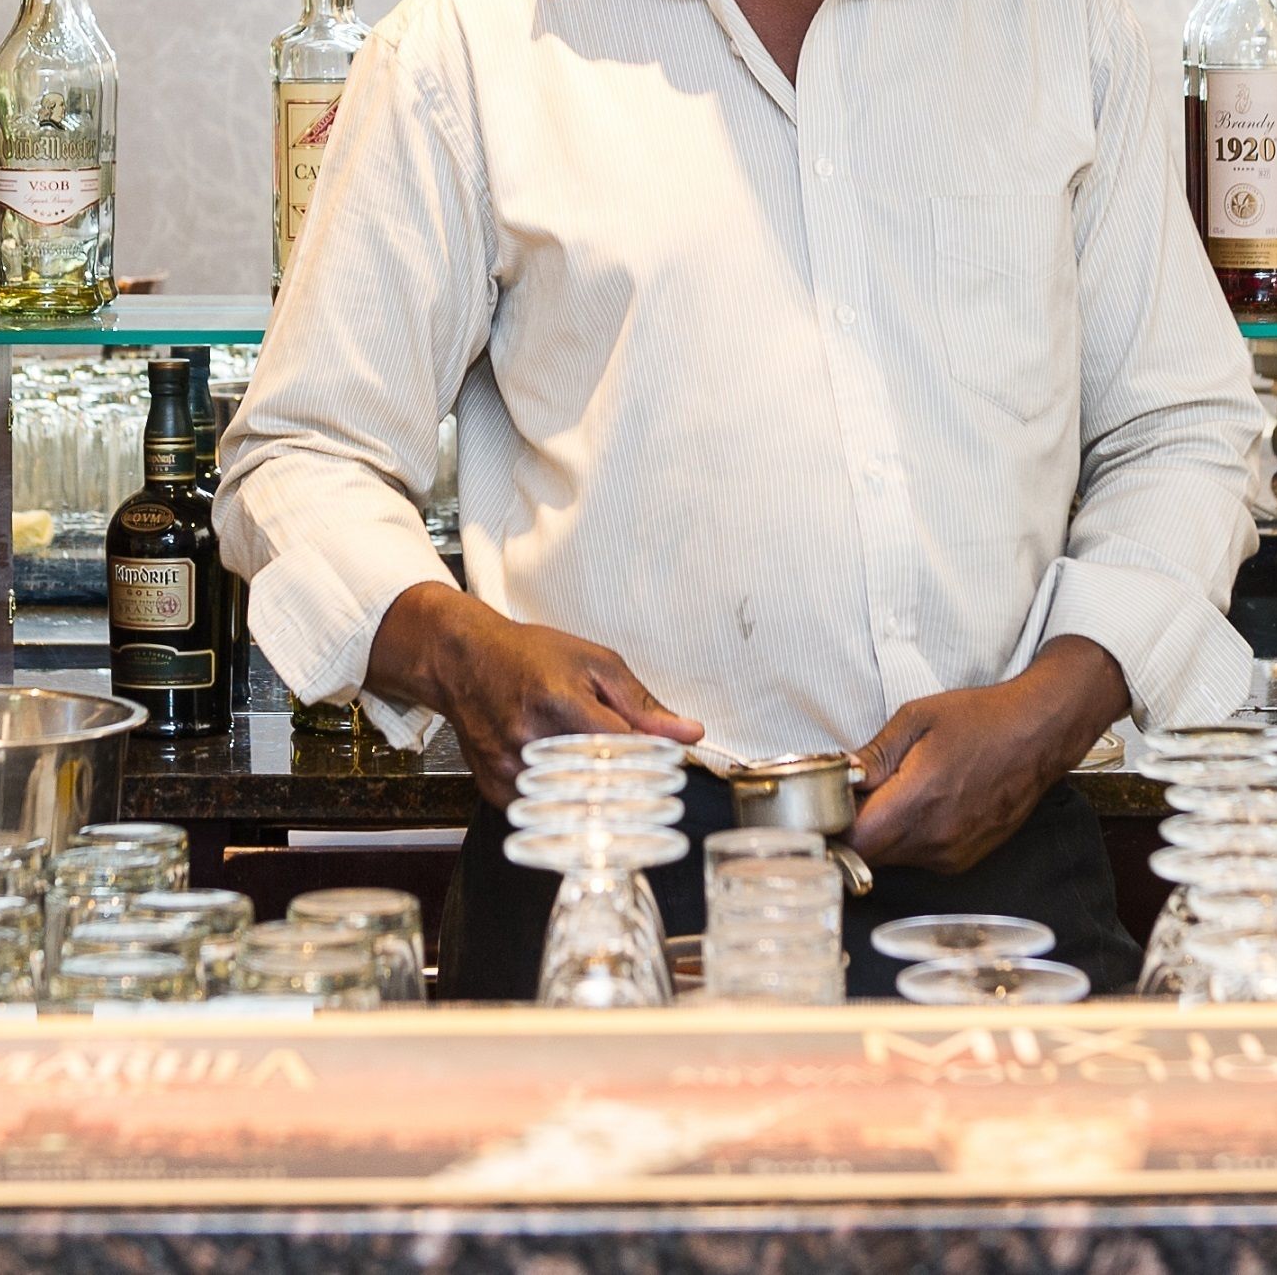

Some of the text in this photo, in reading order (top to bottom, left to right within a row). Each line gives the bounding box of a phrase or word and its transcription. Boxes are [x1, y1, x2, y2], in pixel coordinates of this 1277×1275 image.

[1214, 113, 1275, 135] Brandy
[1215, 137, 1276, 163] 1920
[126, 589, 164, 597] GOLD
